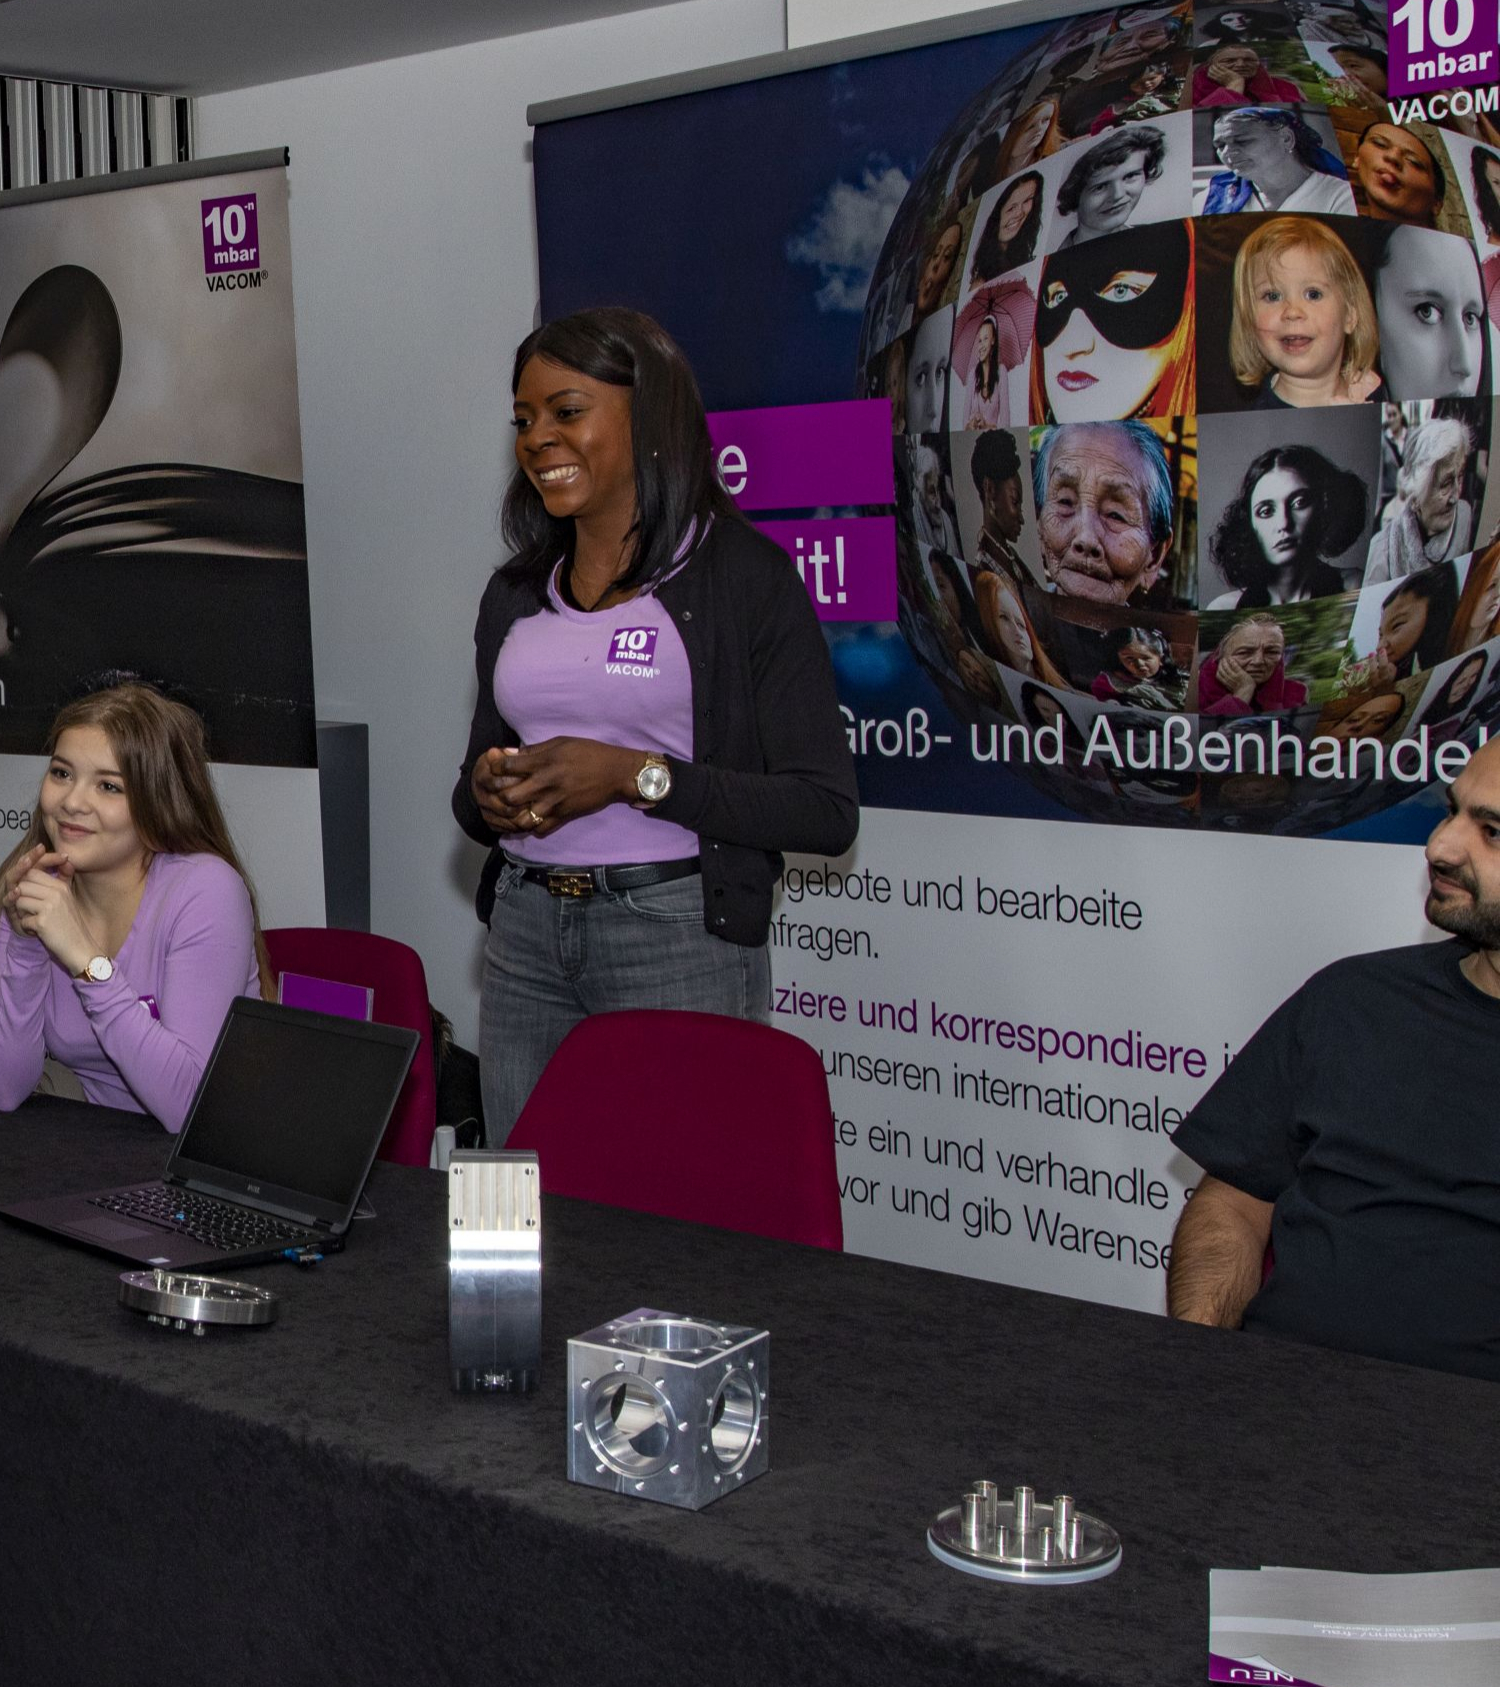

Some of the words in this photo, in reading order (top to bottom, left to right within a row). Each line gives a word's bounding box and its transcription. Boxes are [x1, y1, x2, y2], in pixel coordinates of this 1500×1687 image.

[1407, 50, 1493, 82] mbar
[214, 246, 257, 265] mbar
[615, 650, 652, 662] mbar
[970, 713, 1064, 765] und
[903, 875, 963, 912] und
[976, 876, 1143, 931] bearbeite
[858, 998, 918, 1034] und
[931, 1001, 1207, 1078] korrespondiere
[819, 1048, 941, 1095] unseren
[953, 1062, 1191, 1136] internationale
[868, 1119, 911, 1158] ein
[924, 1137, 984, 1174] und
[995, 1150, 1169, 1210] verhandle
[891, 1187, 950, 1223] und
[962, 1196, 1012, 1239] gib
[1230, 1667, 1294, 1683] NEU
